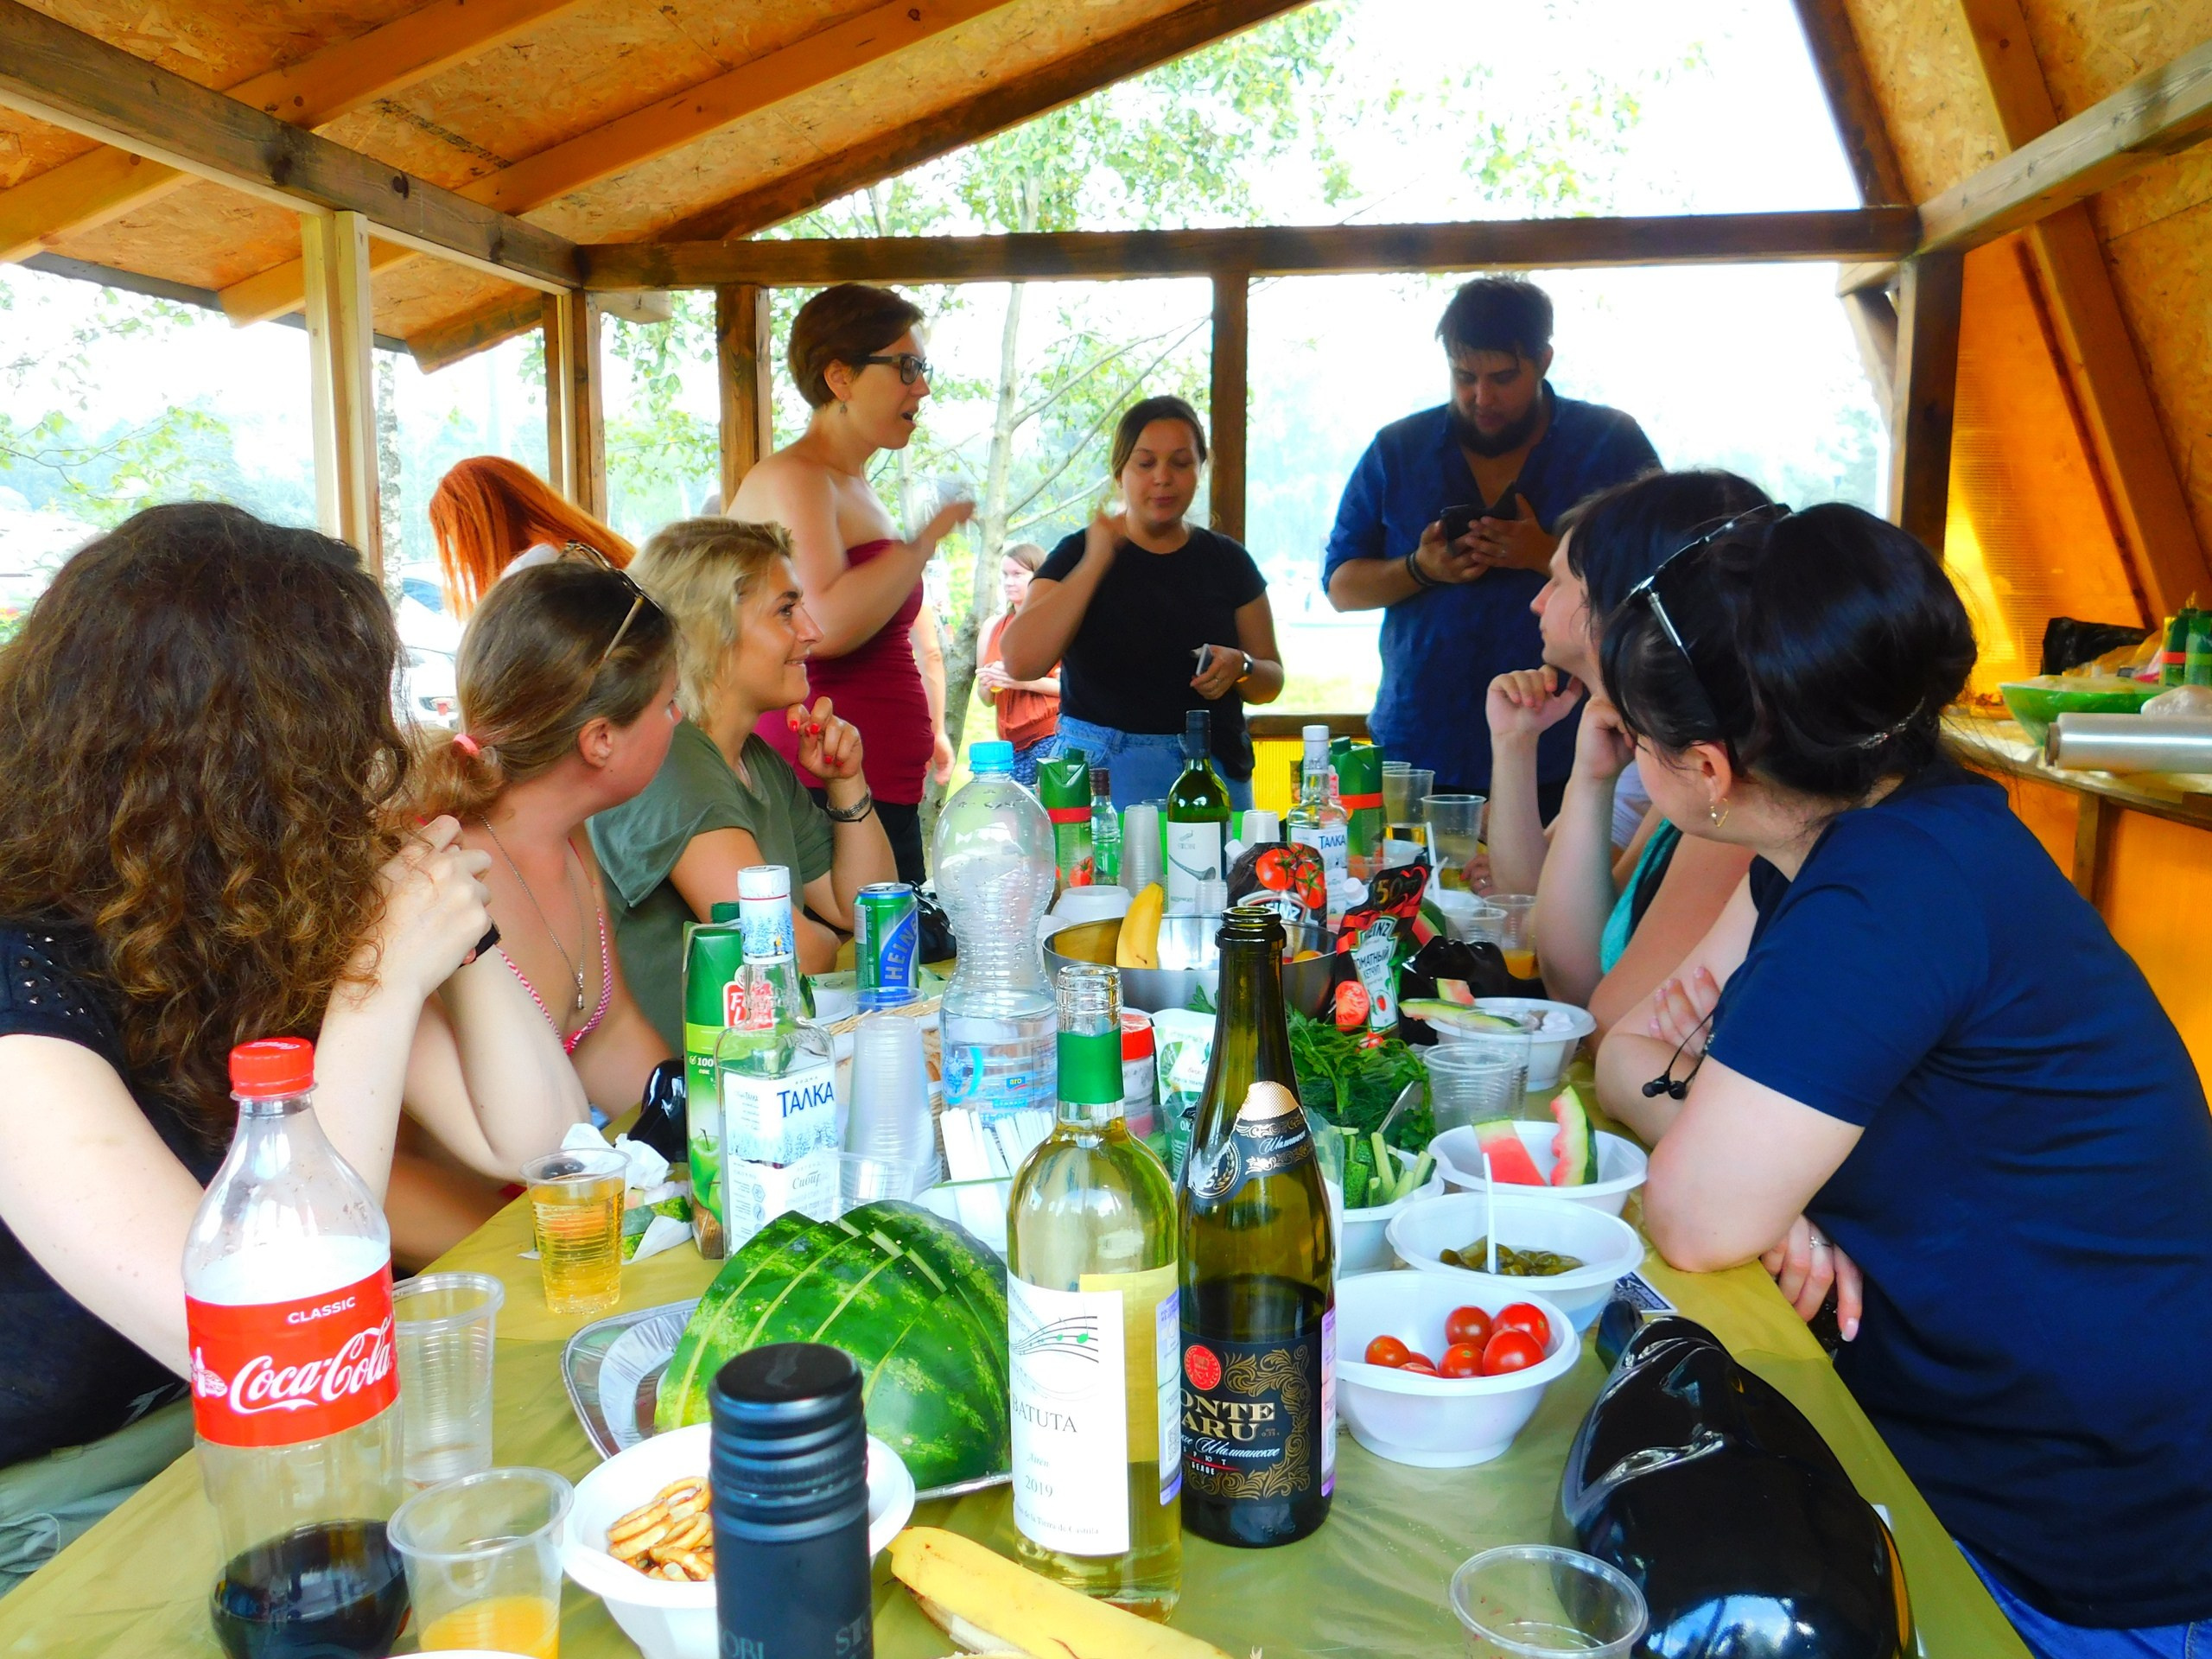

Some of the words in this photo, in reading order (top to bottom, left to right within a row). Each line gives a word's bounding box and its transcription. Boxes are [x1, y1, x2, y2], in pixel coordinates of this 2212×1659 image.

[1319, 835, 1346, 849] ТАЛКА
[1263, 899, 1300, 921] EINZ
[1365, 921, 1391, 939] EINZ
[1356, 945, 1390, 969] ОМАТНЫЙ
[777, 1081, 835, 1118] ТАЛКА
[286, 1295, 356, 1325] CLASSIC
[229, 1313, 393, 1414] Coca-Cola
[1012, 1393, 1077, 1433] BATUTA
[1180, 1388, 1275, 1422] ONTE
[1181, 1410, 1261, 1442] ARU
[1025, 1474, 1053, 1498] 2019
